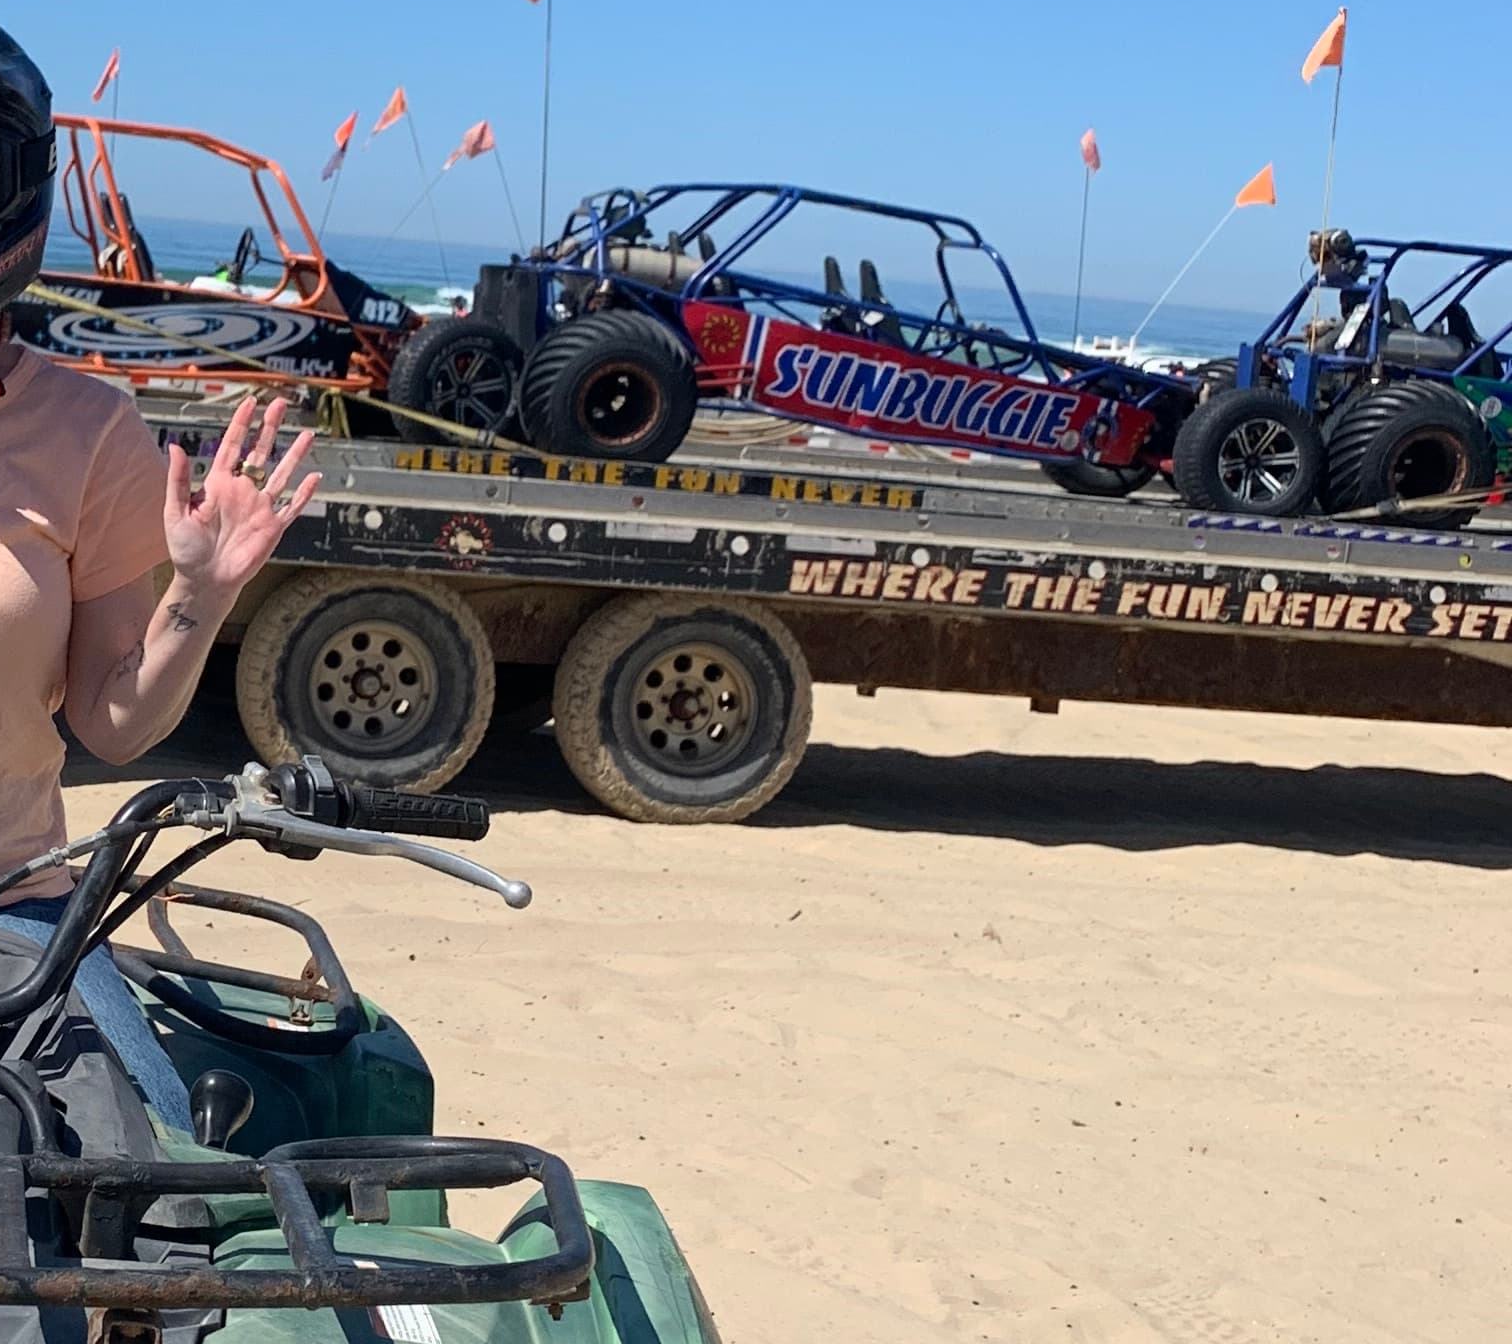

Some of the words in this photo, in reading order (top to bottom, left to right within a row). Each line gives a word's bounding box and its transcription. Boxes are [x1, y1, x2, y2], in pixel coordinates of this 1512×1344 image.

[764, 343, 1080, 449] SUNBUGGIE
[543, 457, 625, 487] THE
[655, 466, 742, 494] FUN
[771, 474, 914, 510] NEVER
[789, 559, 987, 605] WHERE
[1005, 572, 1107, 614] THE
[1117, 581, 1231, 622] FUN
[1242, 590, 1413, 635] NEVER
